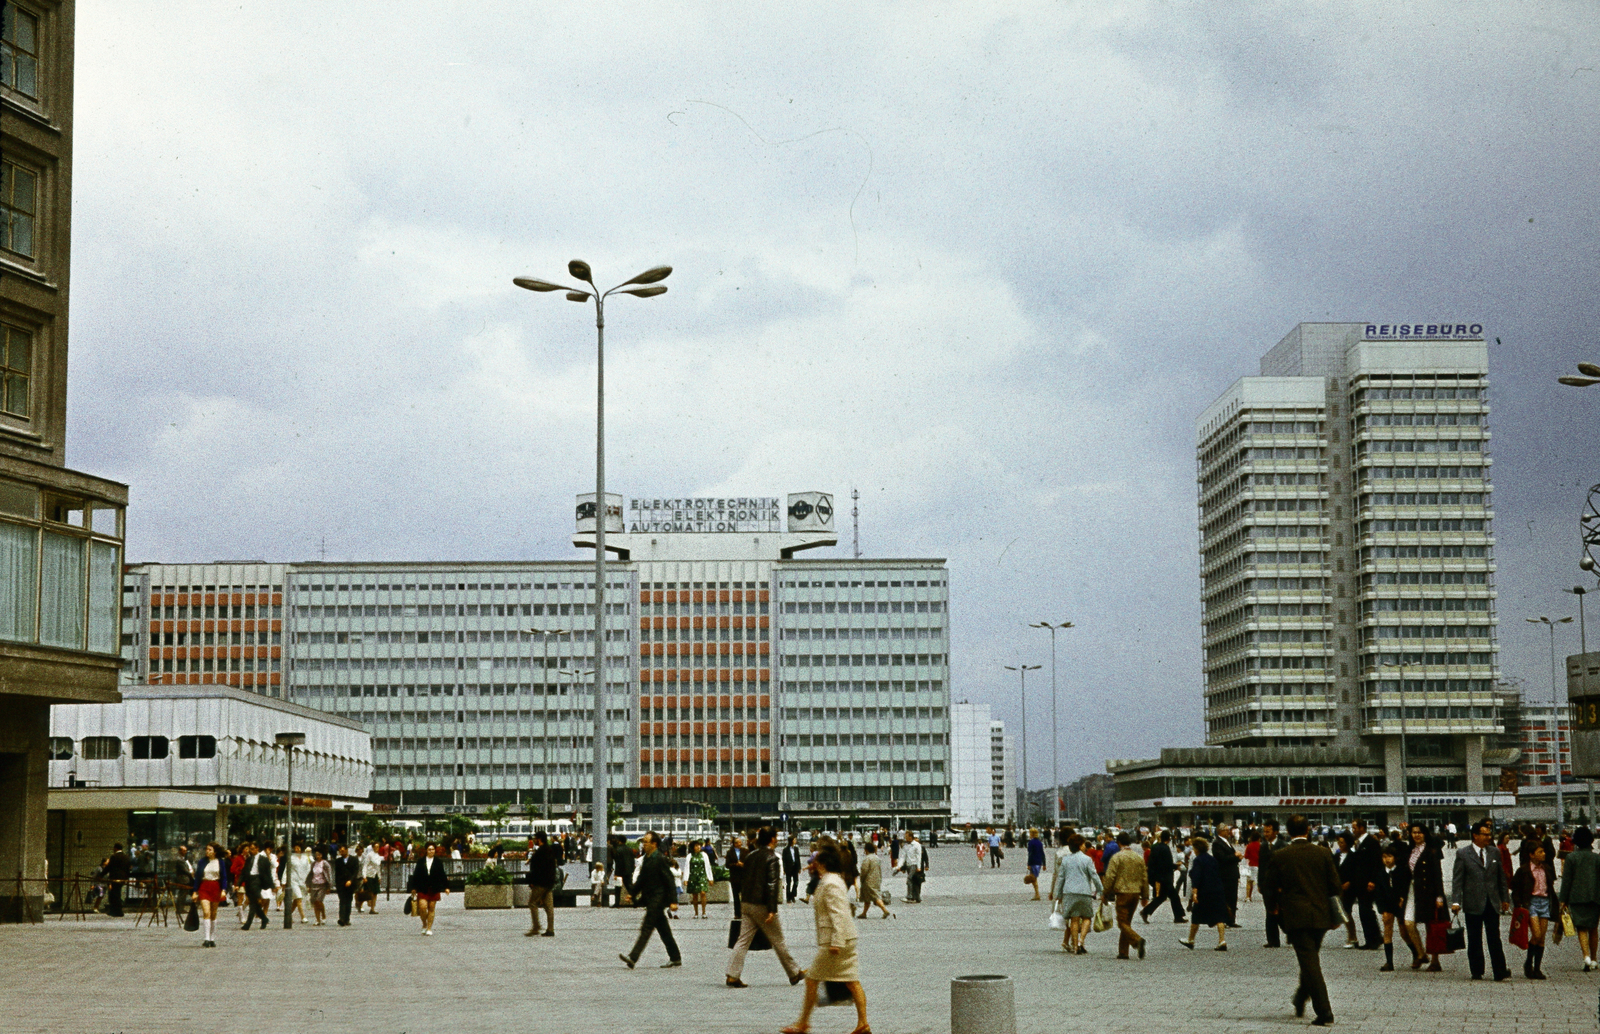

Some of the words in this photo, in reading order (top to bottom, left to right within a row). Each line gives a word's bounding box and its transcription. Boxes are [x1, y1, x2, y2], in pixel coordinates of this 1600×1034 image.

[1365, 323, 1483, 335] REISEBÜRO
[631, 499, 780, 510] ELEKTROTECHNIK
[674, 510, 780, 521] ELEKTRONIK
[631, 522, 736, 532] AUTOMATION
[444, 805, 478, 813] FOTO
[807, 802, 841, 810] FOTO
